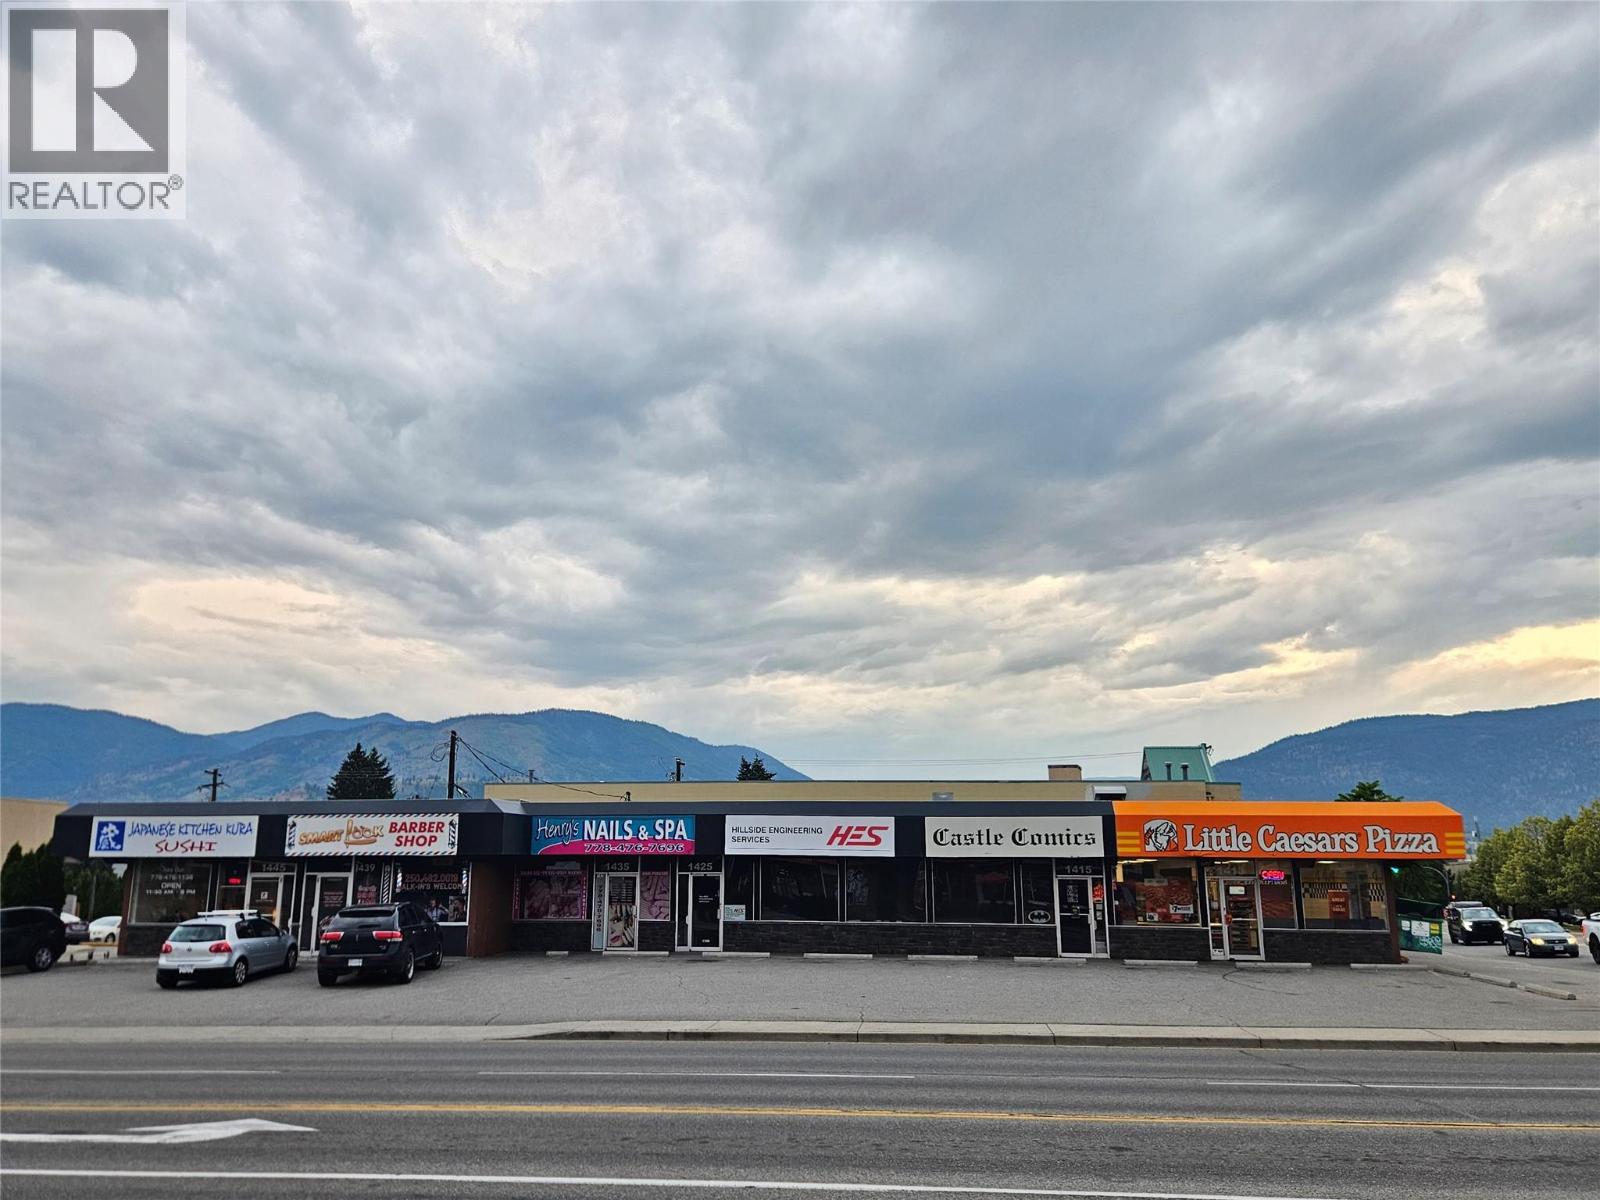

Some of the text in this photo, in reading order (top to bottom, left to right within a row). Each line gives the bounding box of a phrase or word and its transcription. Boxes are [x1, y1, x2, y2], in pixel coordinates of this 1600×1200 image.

[128, 821, 253, 838] JAPANESE KITCHEN KURA
[389, 821, 445, 833] BARBER
[536, 818, 688, 844] Henry's NAILS & SPA
[731, 826, 823, 835] HILLSIDE ENGINEERING
[298, 829, 344, 846] SMART
[395, 835, 438, 847] SHOP
[826, 825, 889, 846] HES
[932, 827, 1096, 846] Castle Comics
[1183, 824, 1440, 854] Little Caesars Pizza
[155, 839, 218, 853] SUSHI
[584, 842, 685, 853] 778-476-7696
[355, 863, 375, 872] 1439
[605, 862, 630, 871] 1435
[688, 862, 713, 871] 1425
[1064, 865, 1092, 874] 1415
[1261, 870, 1285, 880] OPEN
